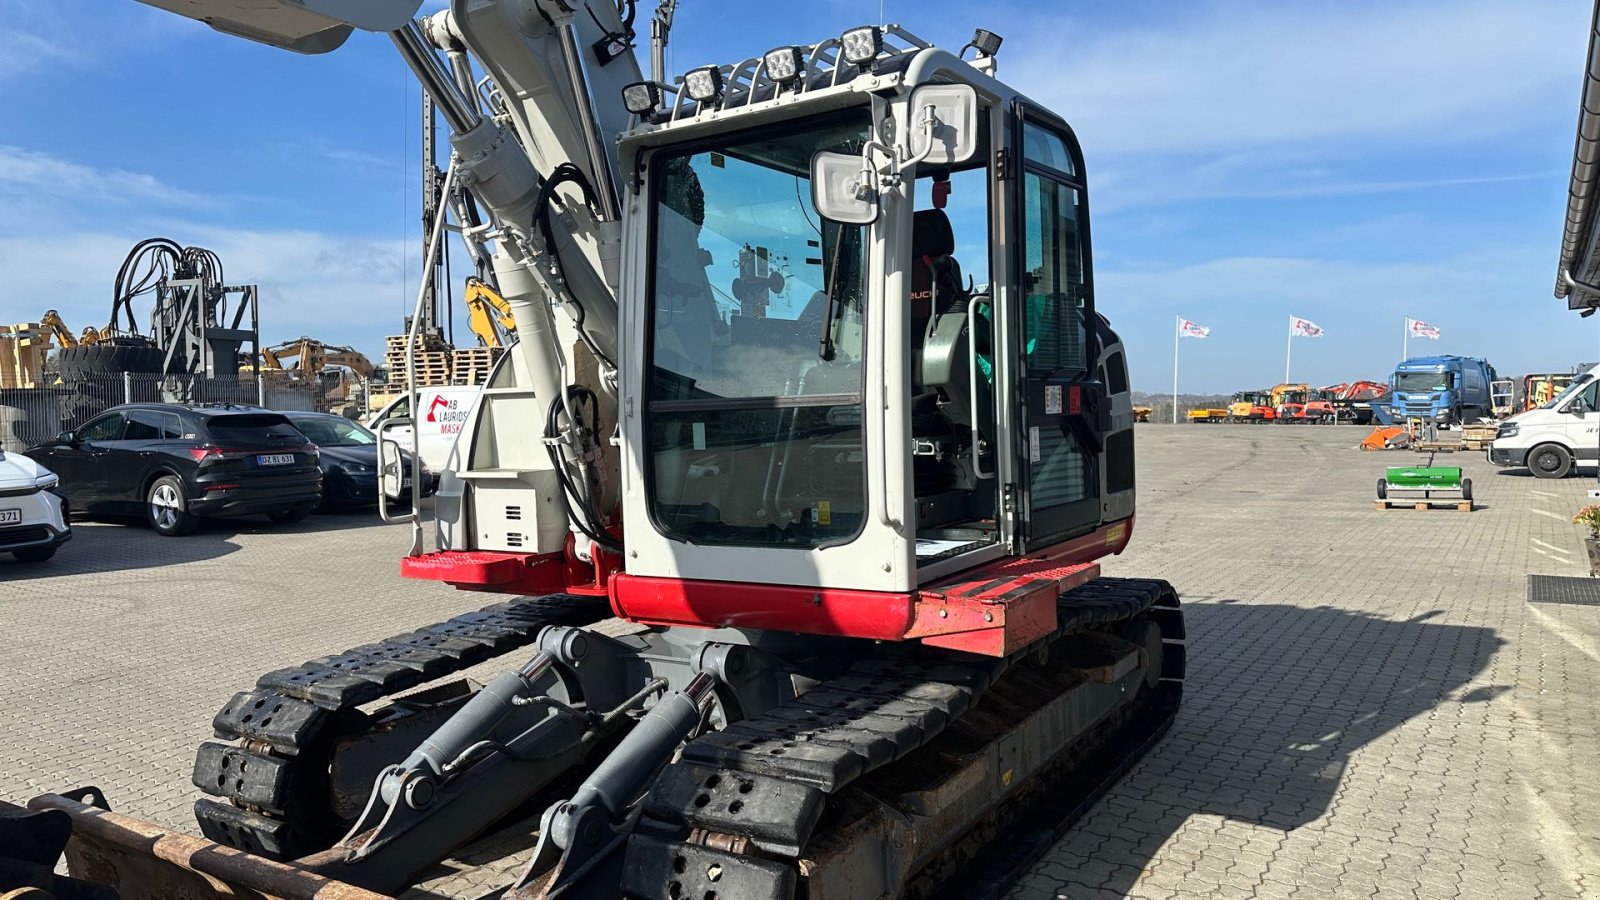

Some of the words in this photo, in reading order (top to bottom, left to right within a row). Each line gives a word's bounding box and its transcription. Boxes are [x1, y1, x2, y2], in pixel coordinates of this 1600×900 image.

[448, 400, 458, 410] AB
[262, 456, 271, 464] DZ
[0, 511, 18, 522] 371
